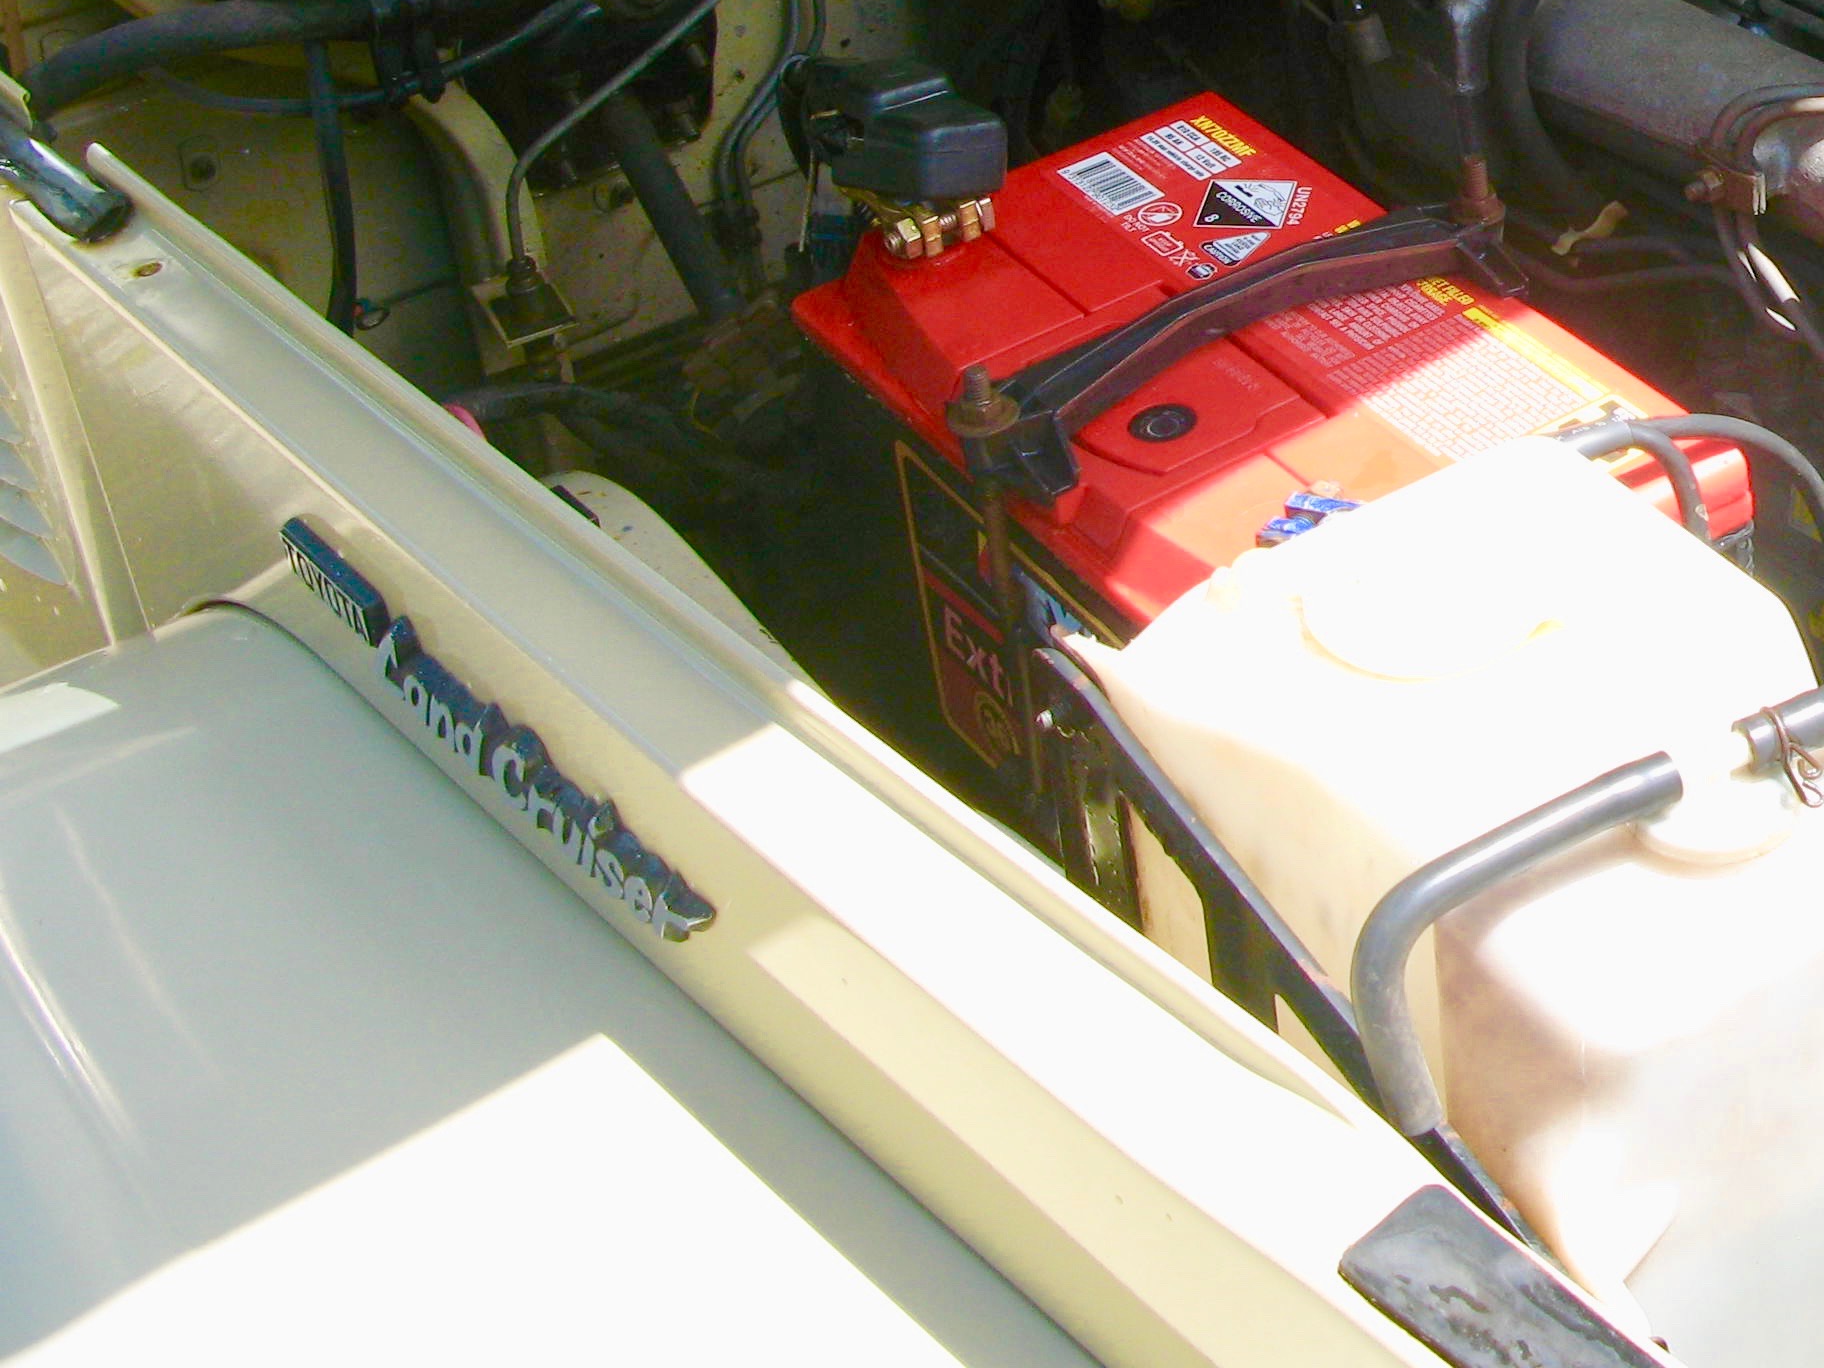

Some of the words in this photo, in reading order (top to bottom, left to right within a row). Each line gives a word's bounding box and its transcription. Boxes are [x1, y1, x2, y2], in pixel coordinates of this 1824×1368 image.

[1189, 114, 1257, 157] XN70ZZMF
[1204, 213, 1220, 223] 8
[1215, 191, 1263, 223] CORROSIVE
[1286, 186, 1313, 226] UN2794
[282, 534, 373, 646] TOYOTA
[376, 618, 490, 778] Land
[491, 730, 714, 942] Cruiser
